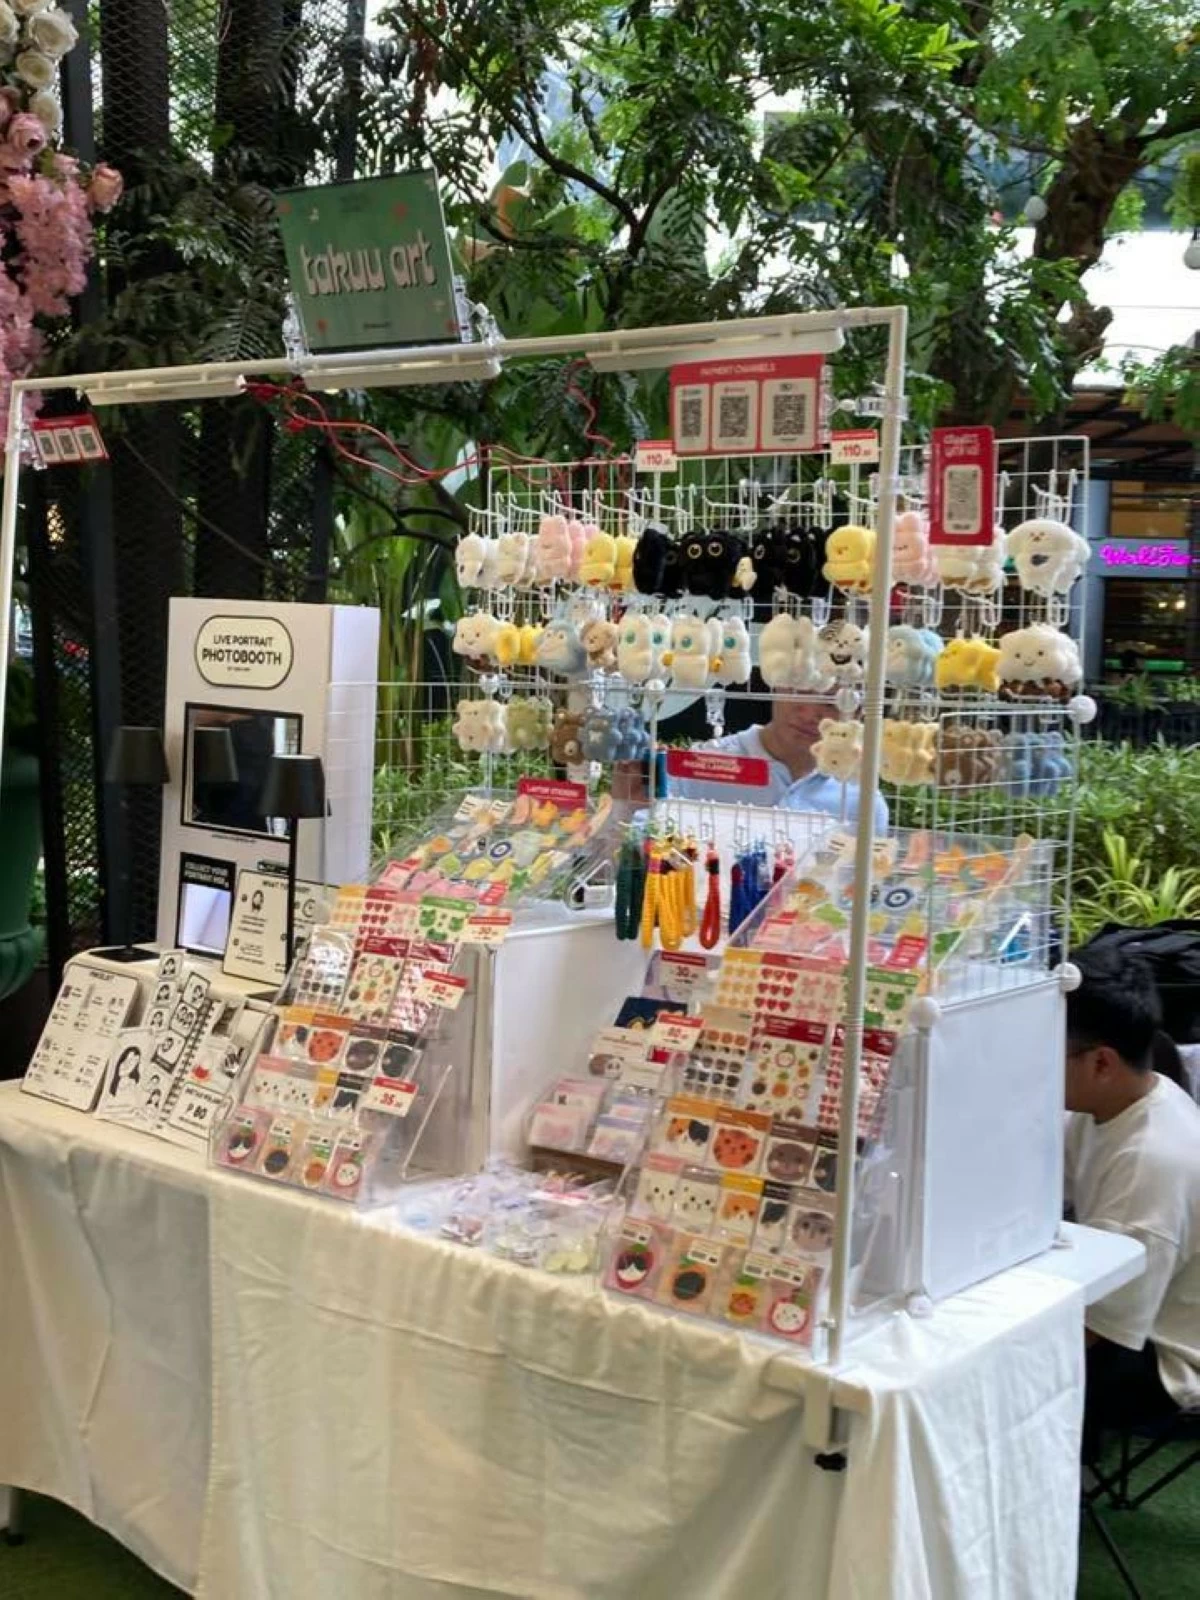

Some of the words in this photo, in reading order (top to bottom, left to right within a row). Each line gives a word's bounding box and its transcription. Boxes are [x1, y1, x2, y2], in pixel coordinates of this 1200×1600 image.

[389, 228, 437, 288] art
[213, 635, 231, 645] LIVE
[232, 635, 275, 647] PORTRAIT
[202, 648, 282, 666] PHOTOBOOTH
